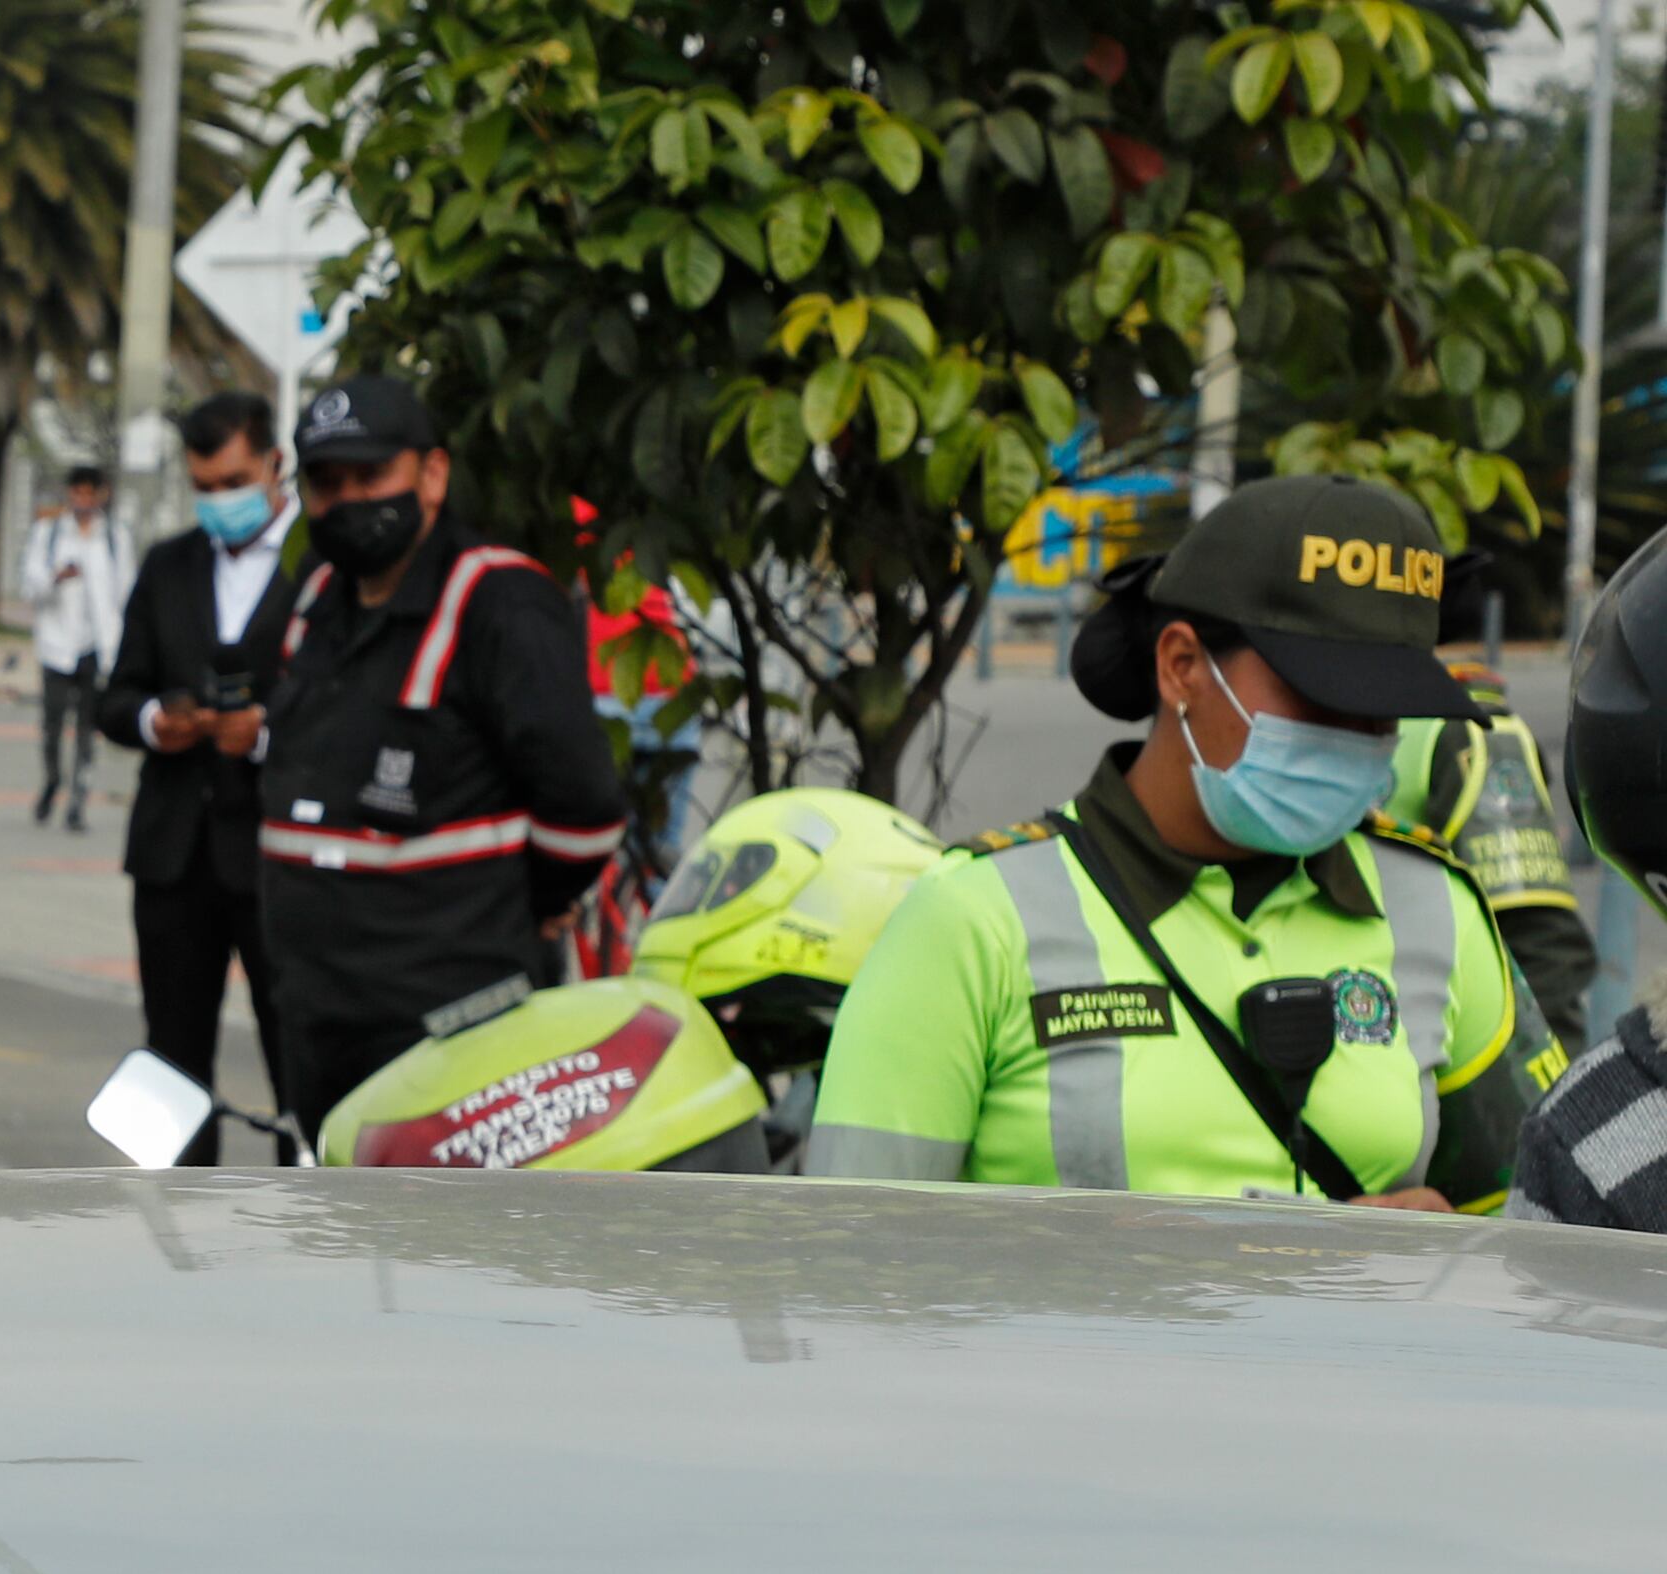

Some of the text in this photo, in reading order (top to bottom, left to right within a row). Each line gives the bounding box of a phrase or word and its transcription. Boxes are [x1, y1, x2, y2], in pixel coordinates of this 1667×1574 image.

[1046, 1007, 1165, 1037] MAYRA DEVIA
[431, 1067, 636, 1165] TRANSPORTE
[443, 1051, 600, 1122] TRANSITO
